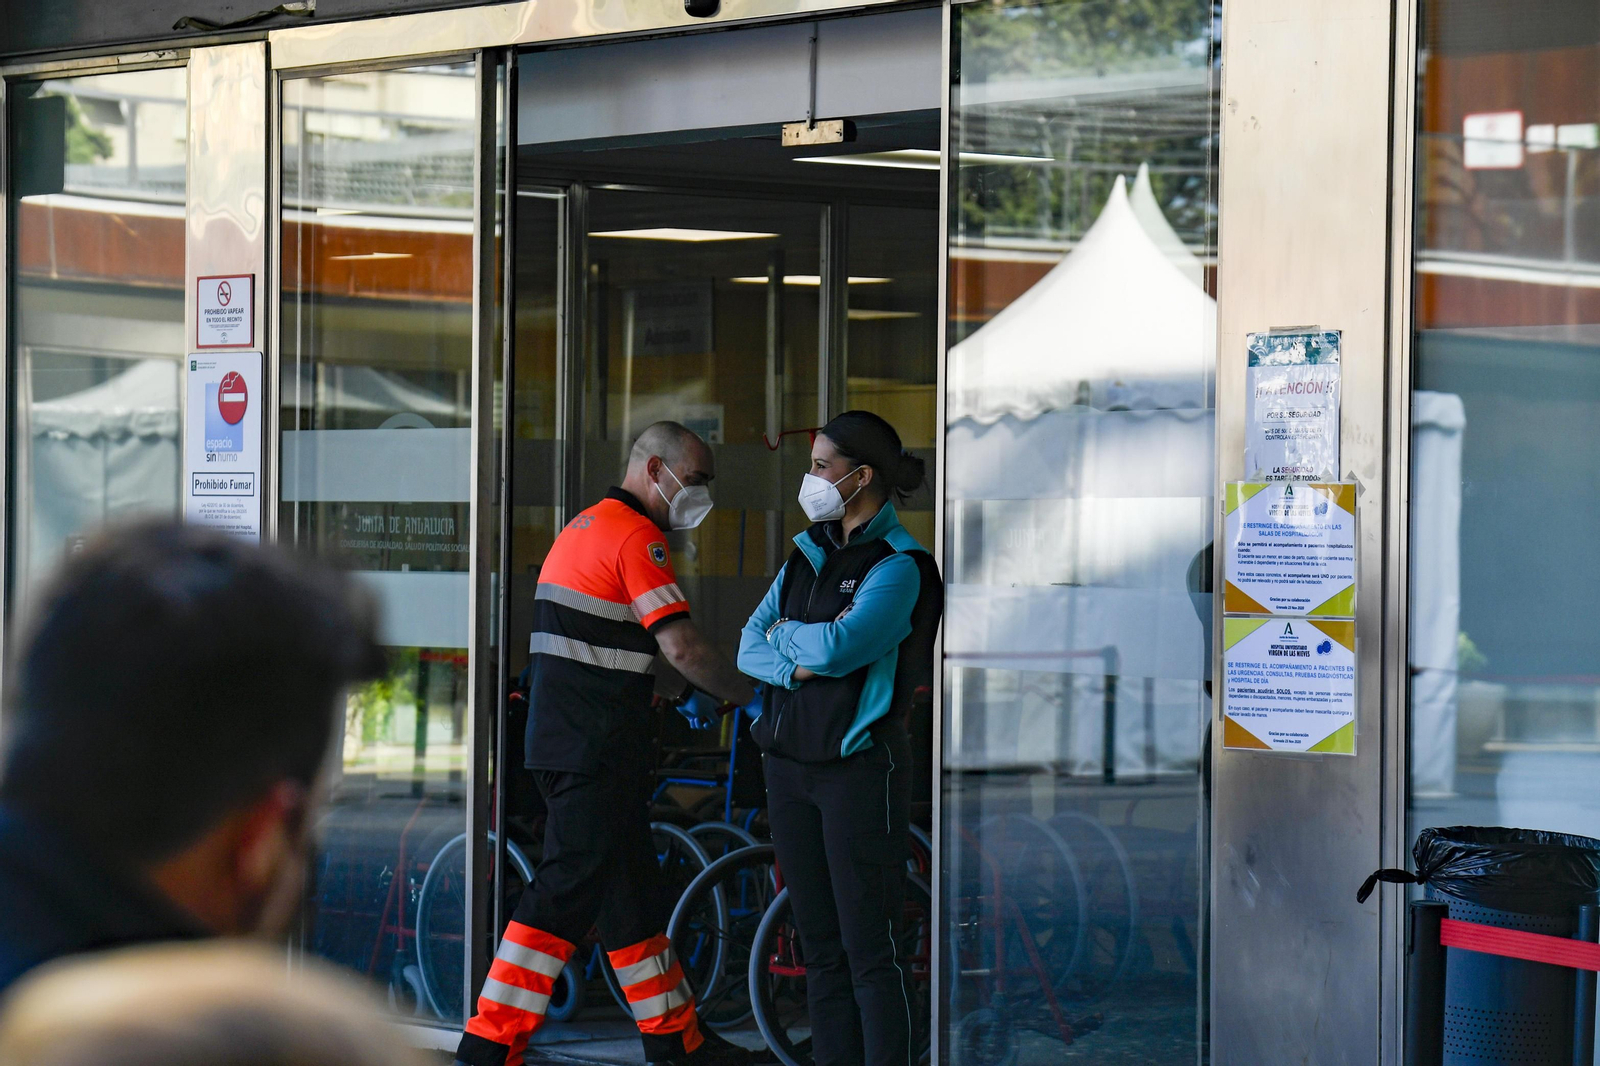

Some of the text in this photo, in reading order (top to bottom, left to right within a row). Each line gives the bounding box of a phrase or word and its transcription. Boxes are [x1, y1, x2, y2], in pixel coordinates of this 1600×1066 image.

[207, 436, 232, 450] espacio
[206, 450, 237, 462] sin humo
[195, 479, 251, 490] Prohibido Fumar
[356, 516, 384, 532] JUNTA
[389, 516, 400, 533] DE
[405, 542, 421, 550] SALUD
